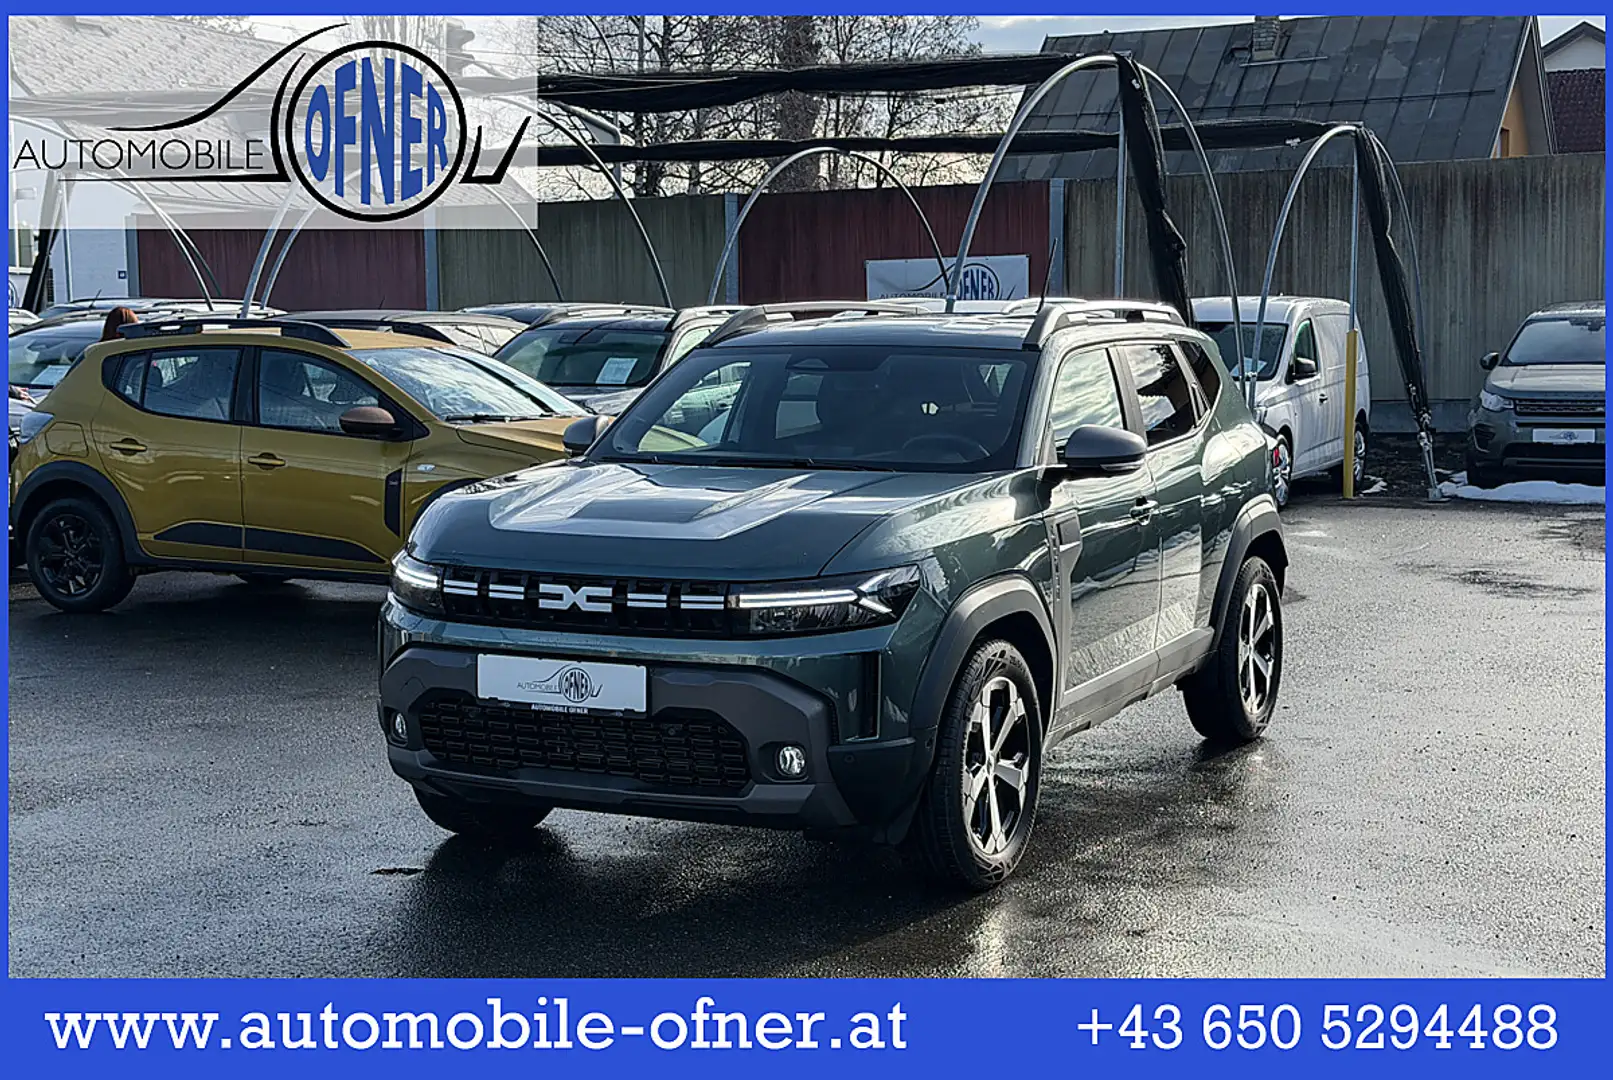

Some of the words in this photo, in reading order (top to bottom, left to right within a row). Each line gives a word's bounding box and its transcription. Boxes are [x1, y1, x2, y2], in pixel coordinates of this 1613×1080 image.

[517, 681, 558, 691] AUTOMOBILE
[564, 671, 589, 700] OFNER
[531, 703, 568, 713] AUTOMOBILE
